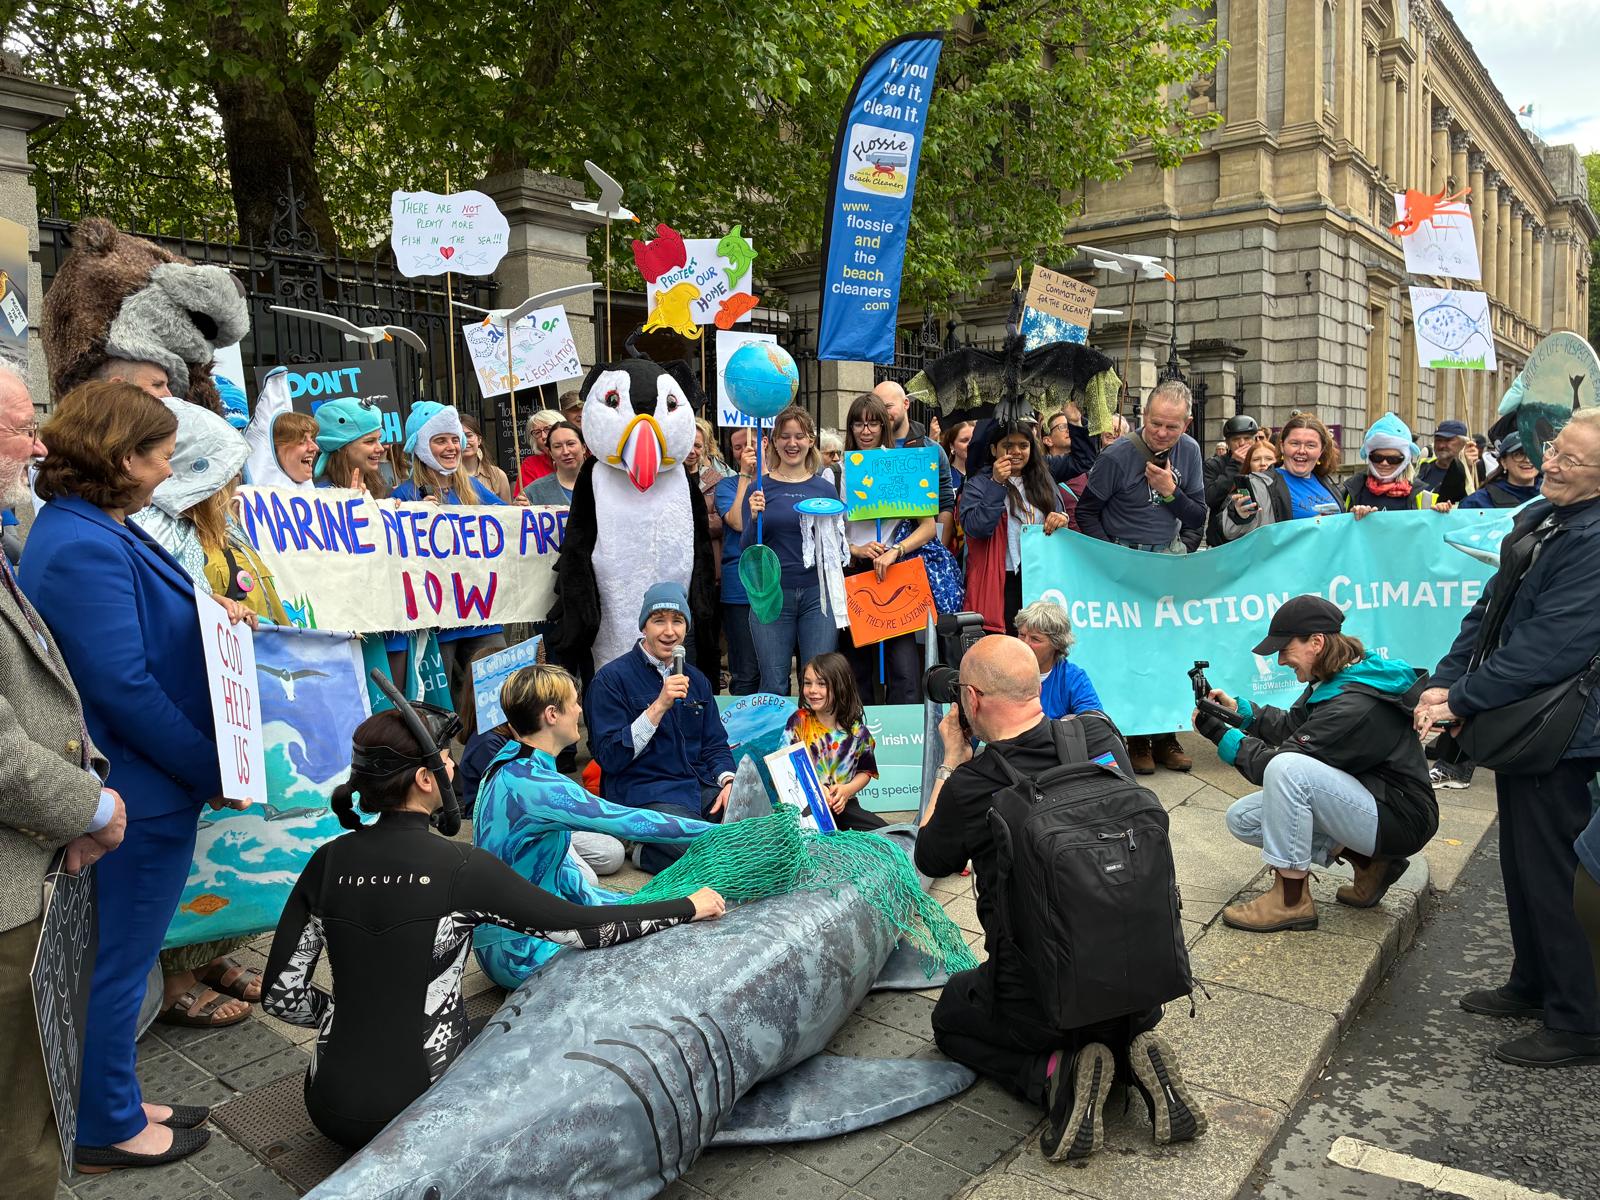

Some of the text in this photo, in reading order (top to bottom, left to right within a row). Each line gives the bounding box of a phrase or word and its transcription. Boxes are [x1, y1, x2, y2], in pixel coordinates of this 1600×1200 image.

[889, 57, 929, 79] If you
[883, 81, 923, 103] see it,
[863, 97, 919, 123] clean it.
[852, 133, 908, 162] Flossie
[399, 197, 482, 215] THERE ARE NOT
[842, 202, 872, 212] www.
[416, 218, 474, 230] PLENTY MORE
[846, 214, 894, 233] flossie
[401, 234, 421, 246] FISH
[430, 235, 438, 245] IN
[449, 235, 465, 244] THE
[854, 235, 881, 249] and
[854, 250, 876, 265] the
[660, 256, 698, 288] PROTECT
[695, 266, 718, 286] OUR
[843, 265, 884, 282] beach
[831, 281, 892, 298] cleaners
[1039, 269, 1052, 280] CAN
[1062, 280, 1077, 291] HEAR
[1079, 285, 1096, 297] SOME
[1045, 283, 1087, 303] COMMOTION
[696, 281, 728, 312] HOME
[862, 301, 890, 311] .com
[1049, 298, 1060, 308] THE
[287, 367, 361, 399] DON'T
[241, 490, 376, 554] MARINE
[1328, 575, 1483, 612] CLIMATE
[866, 613, 897, 629] THEY'RE
[216, 621, 243, 676] COD
[221, 674, 252, 731] HELP
[735, 699, 747, 710] OR
[751, 695, 786, 710] GREED?
[882, 733, 912, 746] Irish
[233, 734, 250, 785] US
